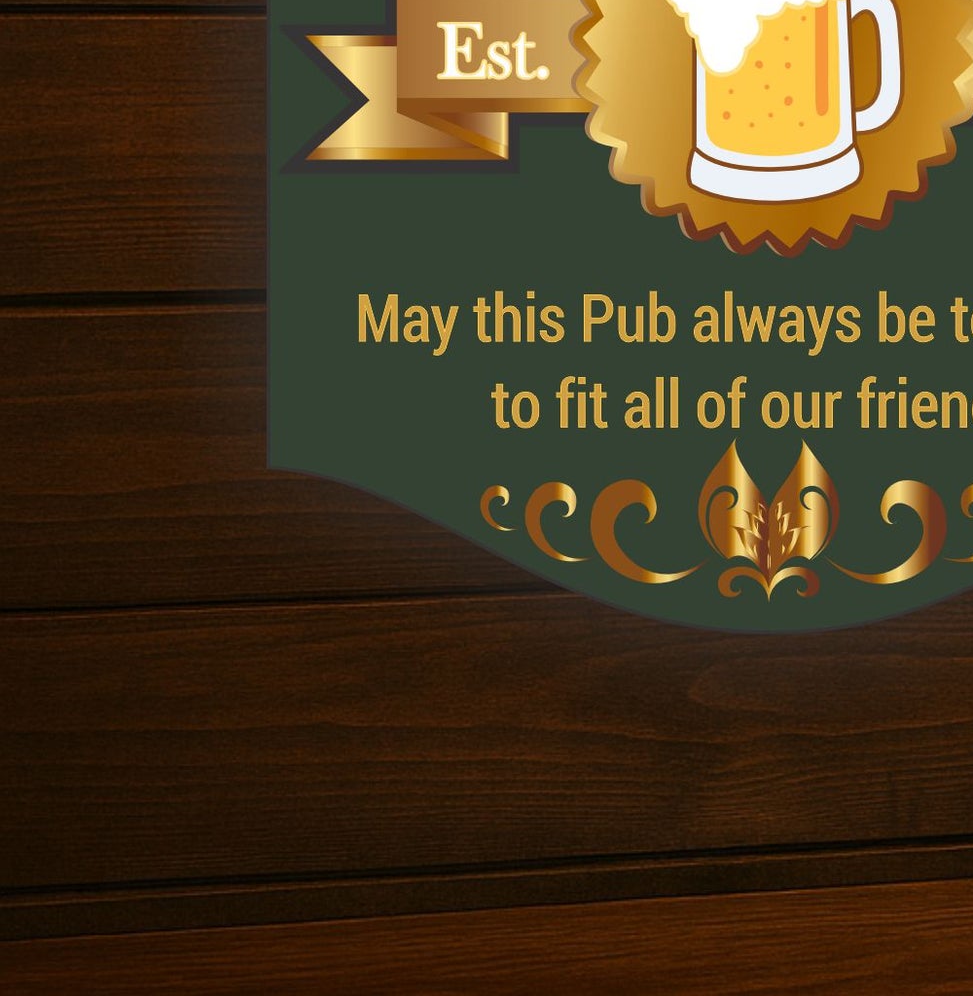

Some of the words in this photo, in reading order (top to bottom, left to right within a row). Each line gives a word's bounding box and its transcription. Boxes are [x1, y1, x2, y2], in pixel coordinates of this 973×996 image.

[437, 22, 550, 80] Est.
[358, 293, 459, 356] May
[473, 291, 565, 343] this
[583, 292, 677, 344] Pub
[694, 291, 861, 357] always
[878, 291, 936, 343] be
[491, 383, 539, 429] to
[556, 376, 608, 429] fit
[624, 376, 679, 429] all
[697, 376, 748, 429] of
[762, 390, 843, 429] our
